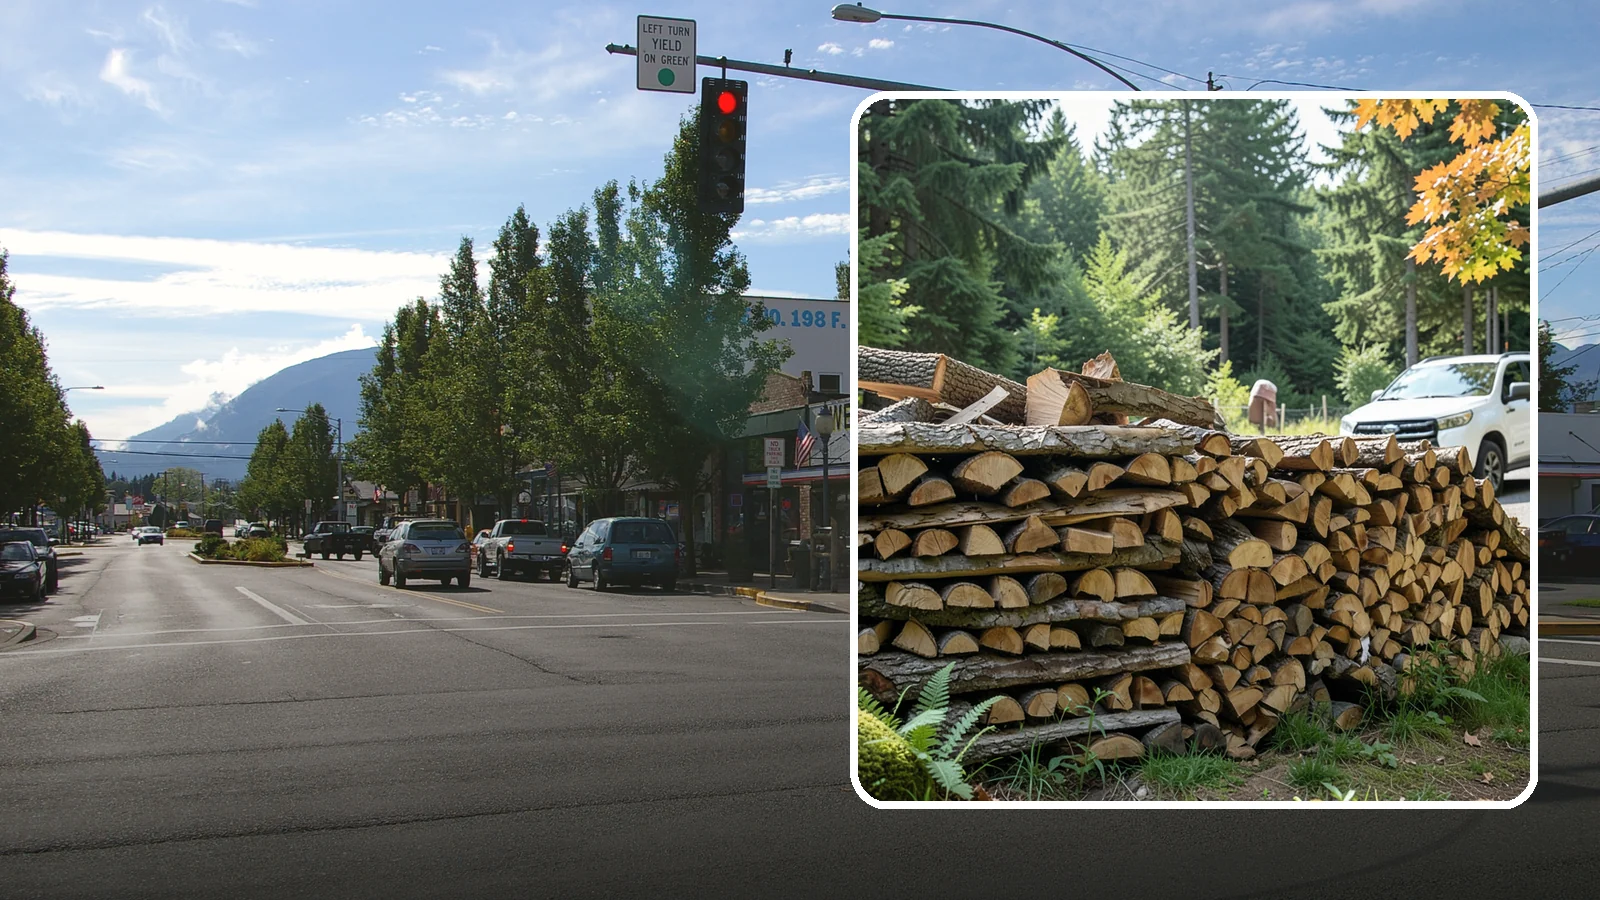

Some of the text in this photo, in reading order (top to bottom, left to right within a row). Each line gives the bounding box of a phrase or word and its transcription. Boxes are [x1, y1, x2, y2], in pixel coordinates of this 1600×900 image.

[643, 23, 690, 36] LEFT TURN
[652, 38, 682, 51] YIELD
[644, 53, 689, 66] ON GREEN
[791, 309, 826, 328] 198
[831, 311, 846, 328] F.
